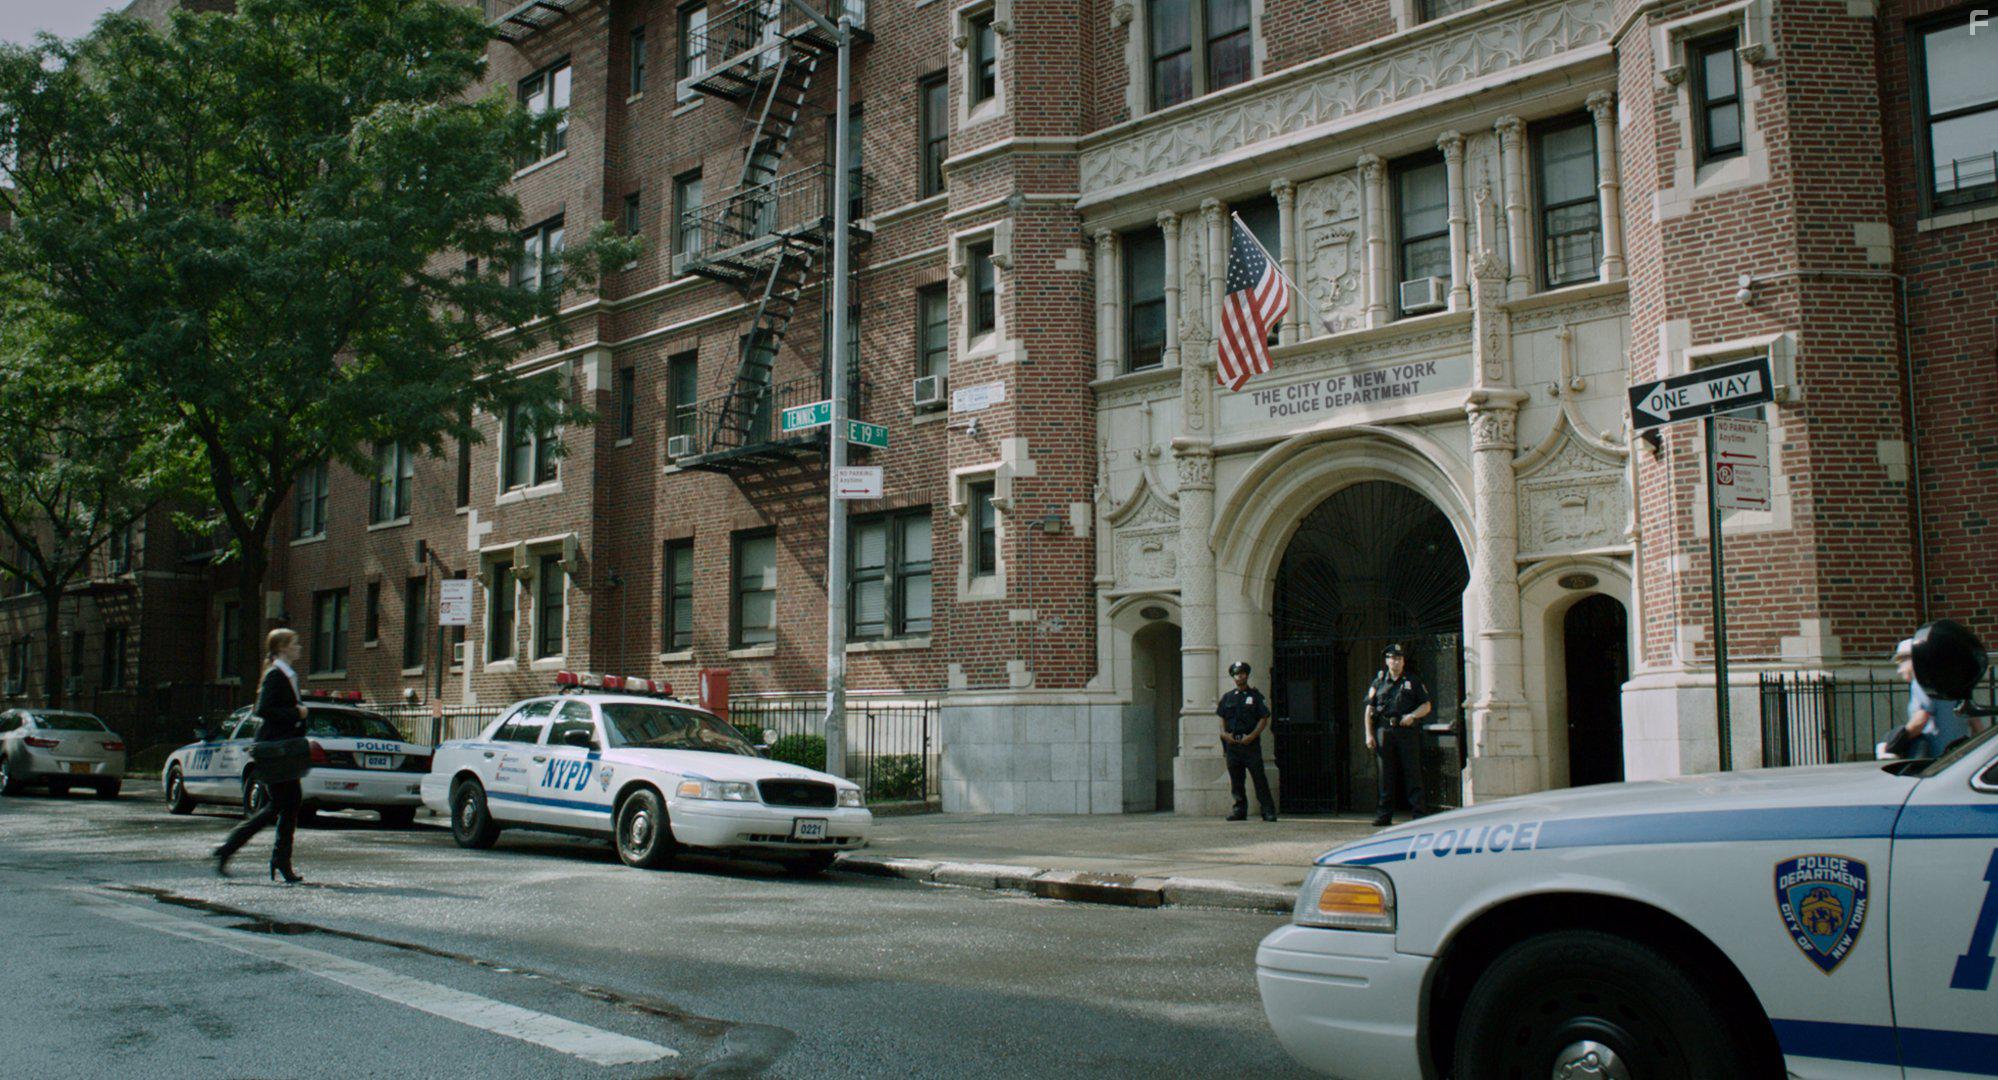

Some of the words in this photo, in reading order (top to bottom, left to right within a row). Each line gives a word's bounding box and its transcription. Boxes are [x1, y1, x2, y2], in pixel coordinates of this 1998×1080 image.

[1252, 388, 1281, 406] THE
[1286, 381, 1320, 401] CITY
[1326, 376, 1346, 394] OF
[1352, 370, 1386, 389] NEW
[1392, 361, 1436, 381] YORK
[1651, 388, 1690, 412] ONE
[1708, 374, 1750, 399] WAY
[1269, 400, 1320, 418] POLICE
[1325, 380, 1420, 409] DEPARTMENT
[786, 406, 816, 429] TENNIS
[821, 403, 829, 415] CT
[1718, 422, 1727, 430] NO
[1729, 423, 1758, 433] PARKING
[850, 422, 858, 440] E
[861, 425, 872, 442] 19
[875, 428, 884, 438] ST
[1718, 433, 1746, 442] Anytime
[356, 742, 401, 752] POLICE
[541, 758, 593, 791] NYPD
[801, 824, 822, 835] 0221
[1409, 821, 1540, 860] POLICE
[1797, 856, 1849, 873] POLICE
[1779, 869, 1866, 891] DEPARTMENT
[1781, 903, 1800, 931] CITY
[1797, 936, 1814, 951] OF
[1831, 934, 1853, 959] NEW
[1849, 898, 1867, 929] YORK
